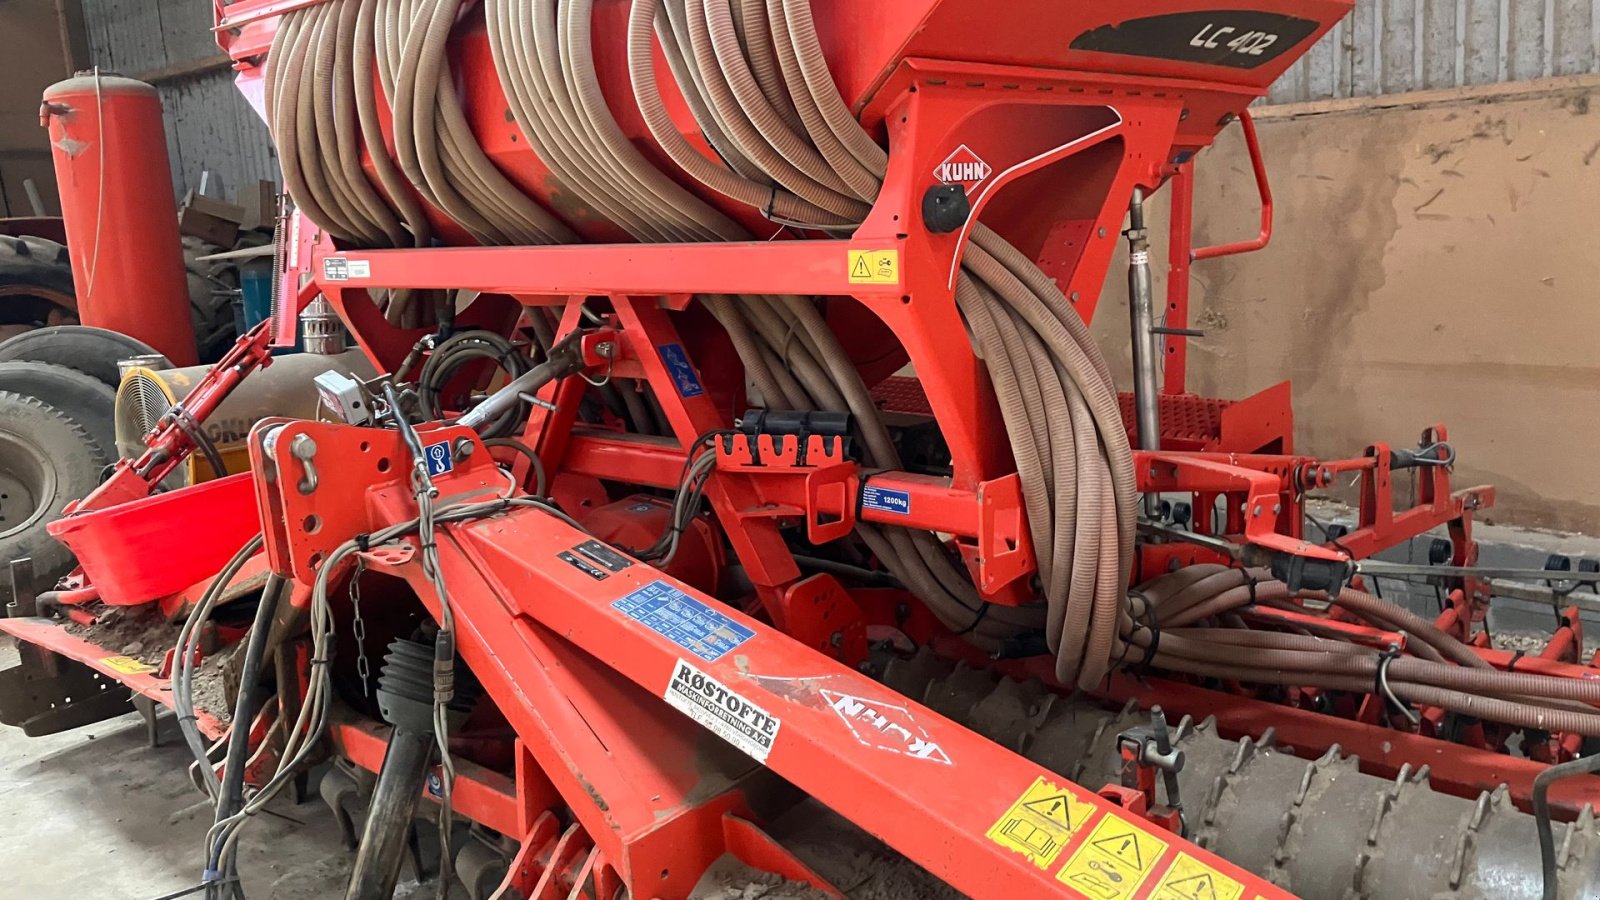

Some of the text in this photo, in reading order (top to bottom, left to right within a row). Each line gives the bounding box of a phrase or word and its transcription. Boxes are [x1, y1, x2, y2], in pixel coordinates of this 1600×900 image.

[1190, 24, 1278, 55] LC 402
[942, 162, 984, 181] KUHN
[883, 496, 907, 507] 1200kg
[676, 683, 752, 737] MASKINFORRETNING
[751, 731, 768, 745] A/S
[677, 664, 777, 736] RØSTOFTE
